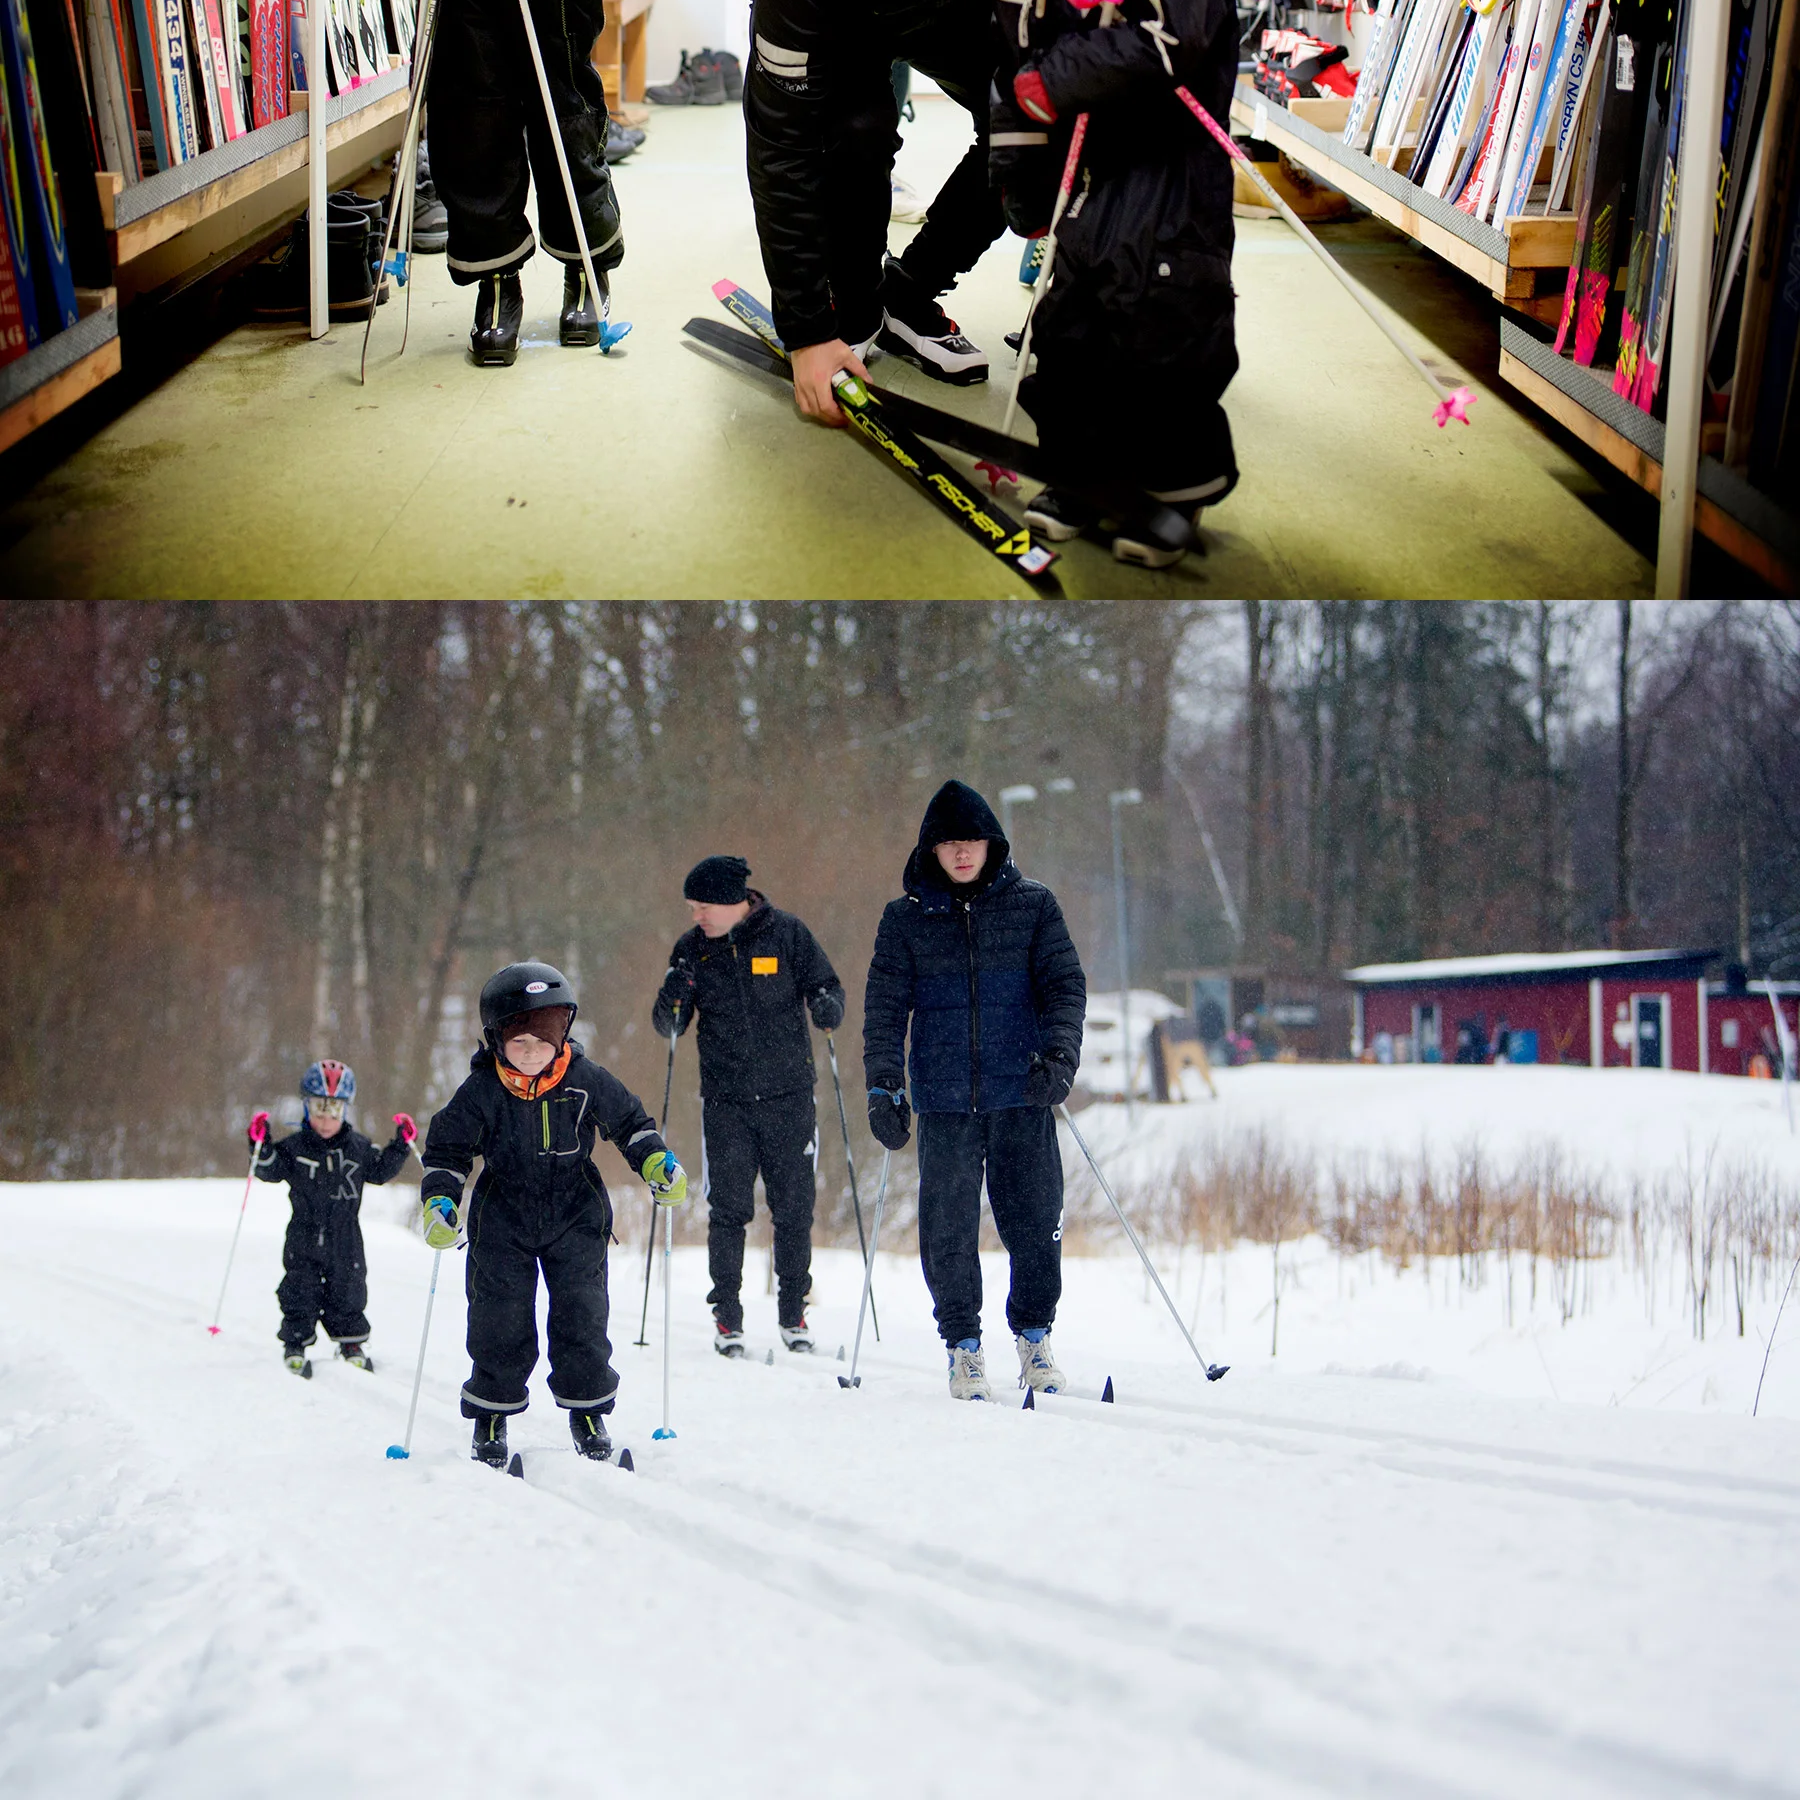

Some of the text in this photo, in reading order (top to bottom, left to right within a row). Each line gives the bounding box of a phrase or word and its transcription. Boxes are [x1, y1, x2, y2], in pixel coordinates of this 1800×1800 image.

[164, 0, 183, 61] 434
[1570, 51, 1583, 79] CS
[1513, 87, 1531, 153] APOLLO
[928, 473, 1006, 541] FISCHER
